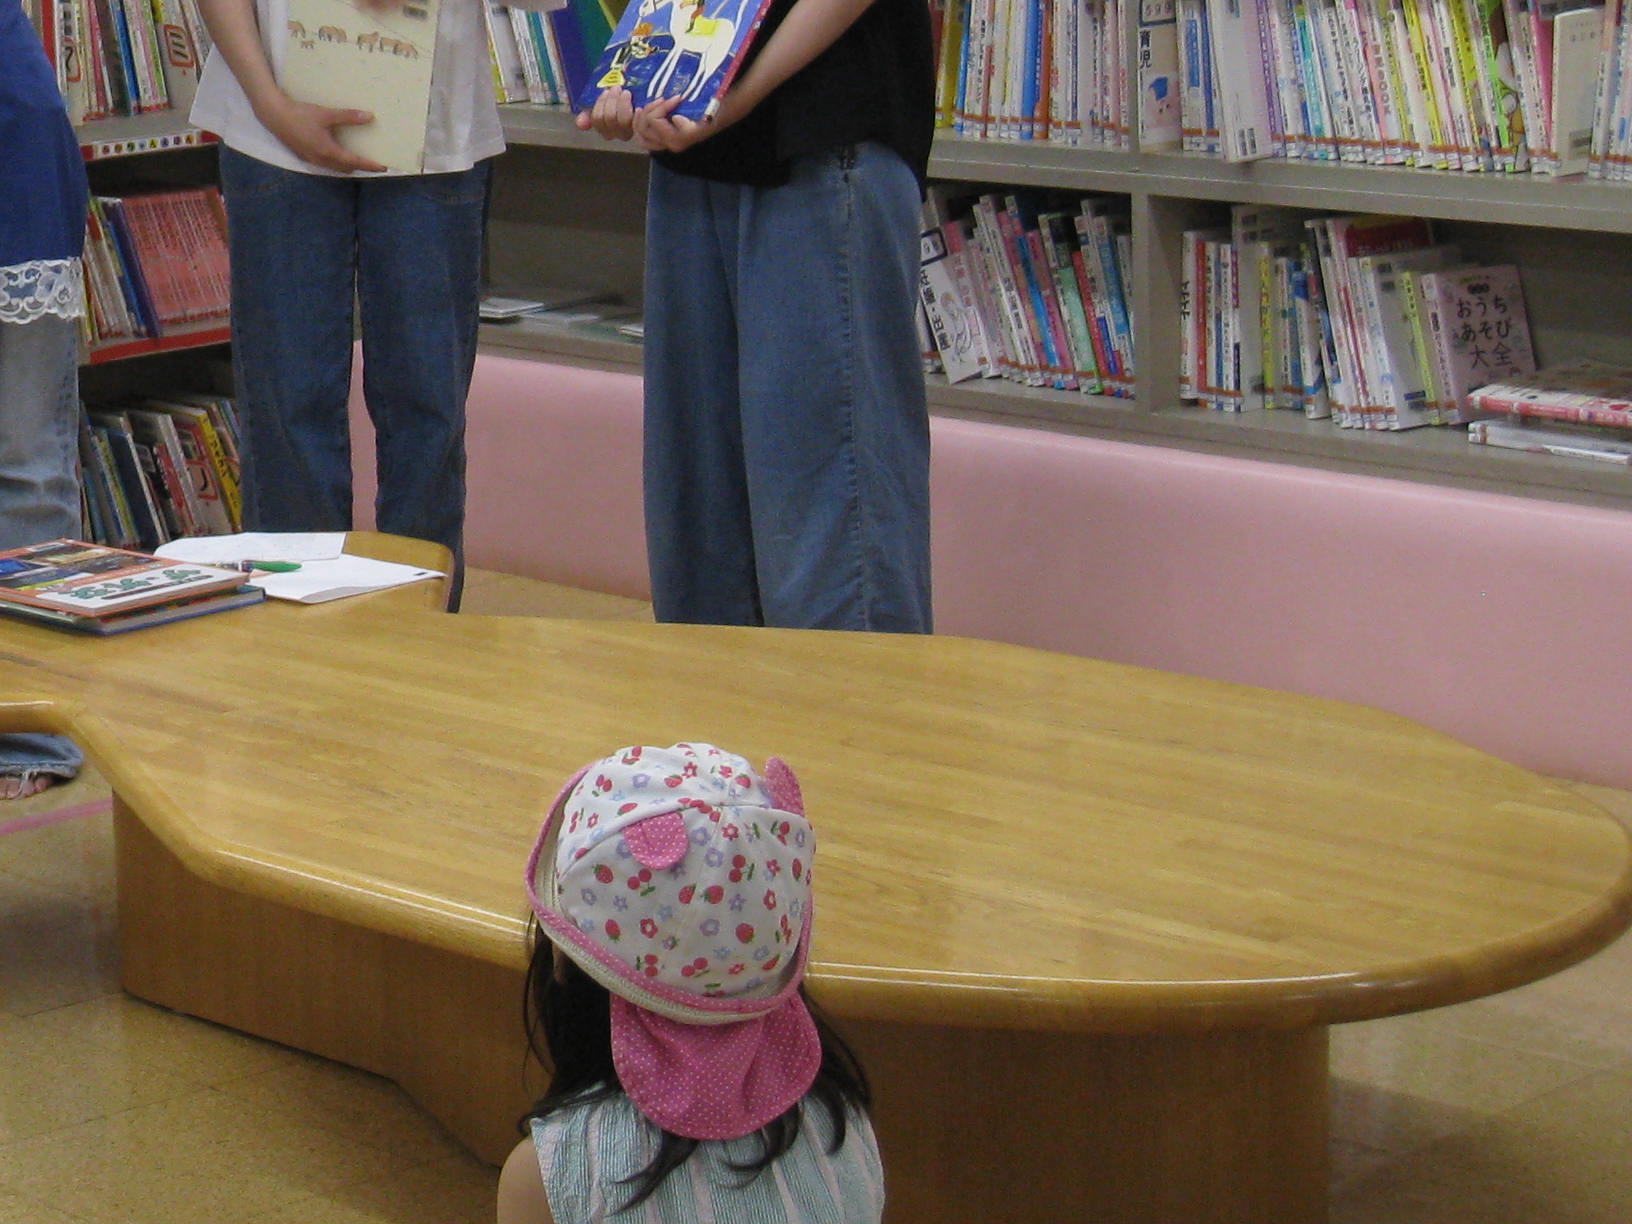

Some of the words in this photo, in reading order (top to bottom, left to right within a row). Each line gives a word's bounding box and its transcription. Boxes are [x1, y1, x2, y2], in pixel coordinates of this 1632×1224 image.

[1140, 31, 1152, 69] 育児
[1456, 295, 1508, 319] おうち
[1461, 318, 1512, 341] あそび
[1470, 341, 1513, 368] 大全
